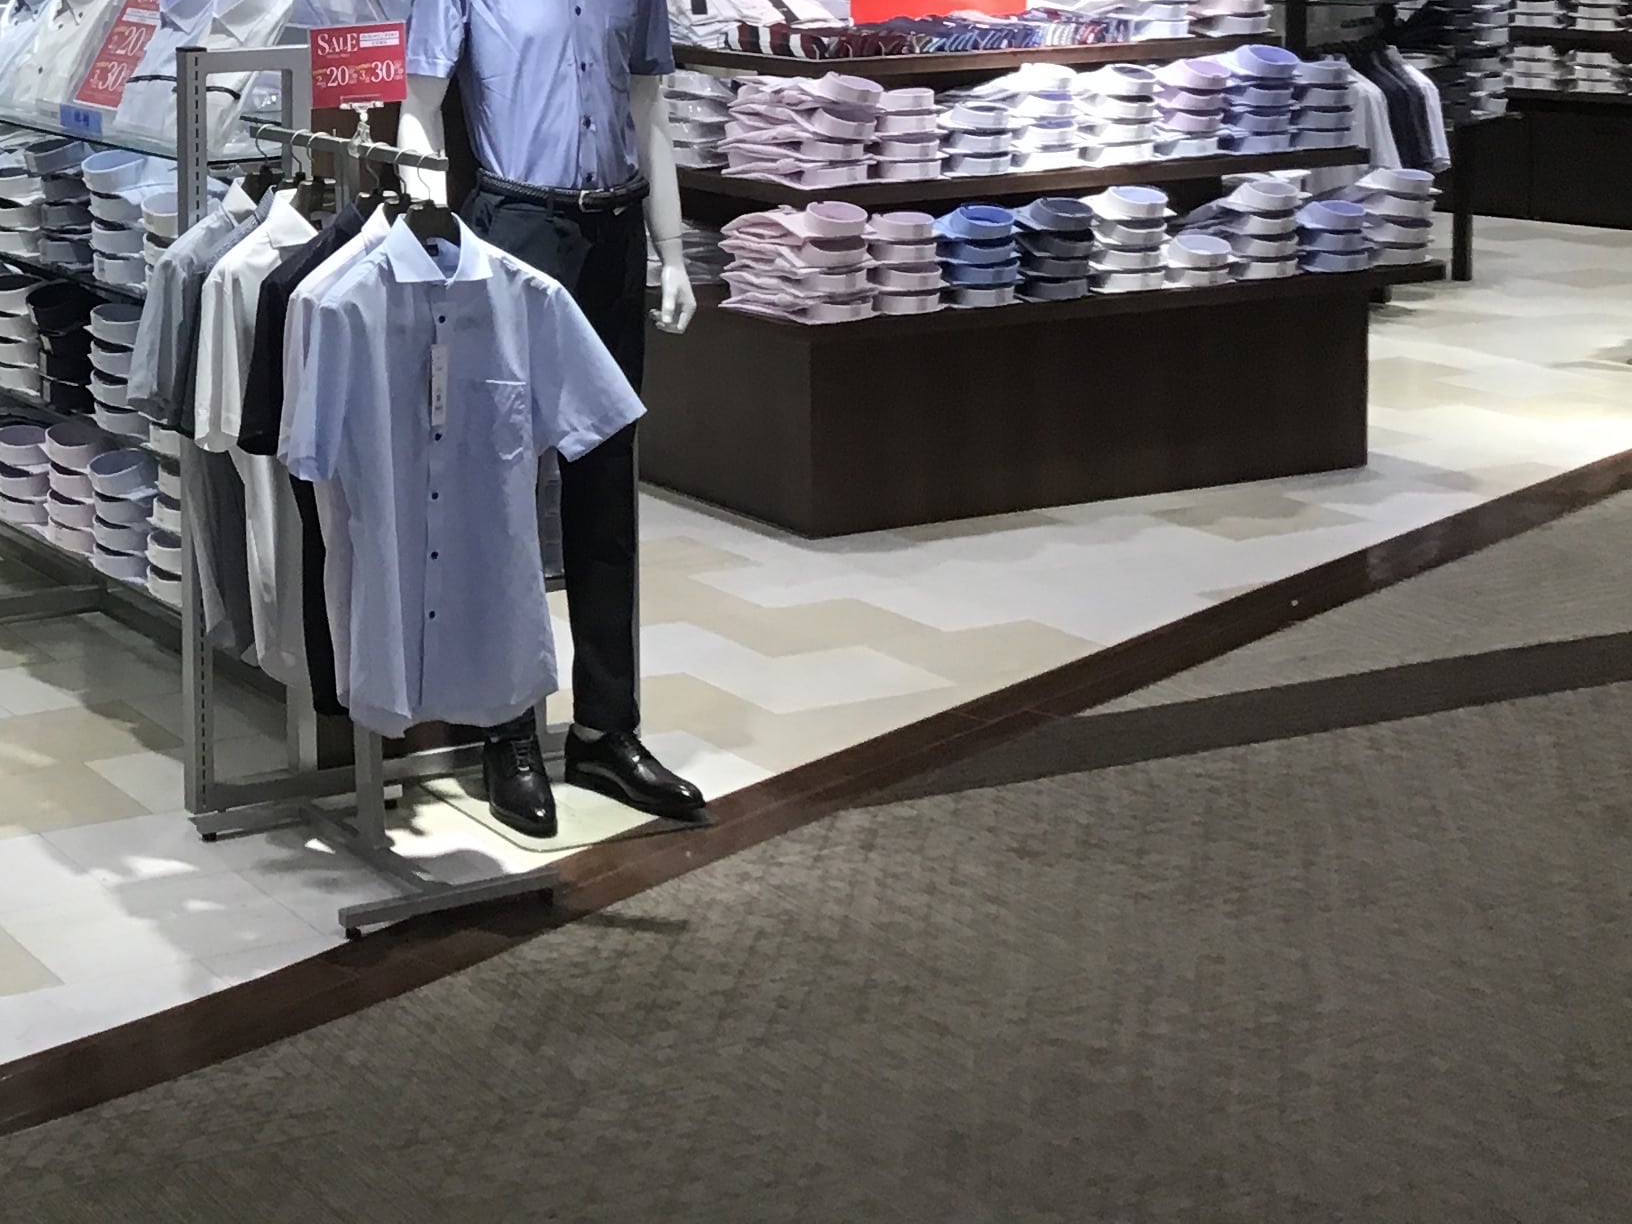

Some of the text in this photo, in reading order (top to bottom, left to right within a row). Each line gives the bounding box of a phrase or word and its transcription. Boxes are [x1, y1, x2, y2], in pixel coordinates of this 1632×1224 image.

[317, 33, 358, 56] SALE
[327, 65, 349, 87] 20
[371, 60, 395, 83] 30
